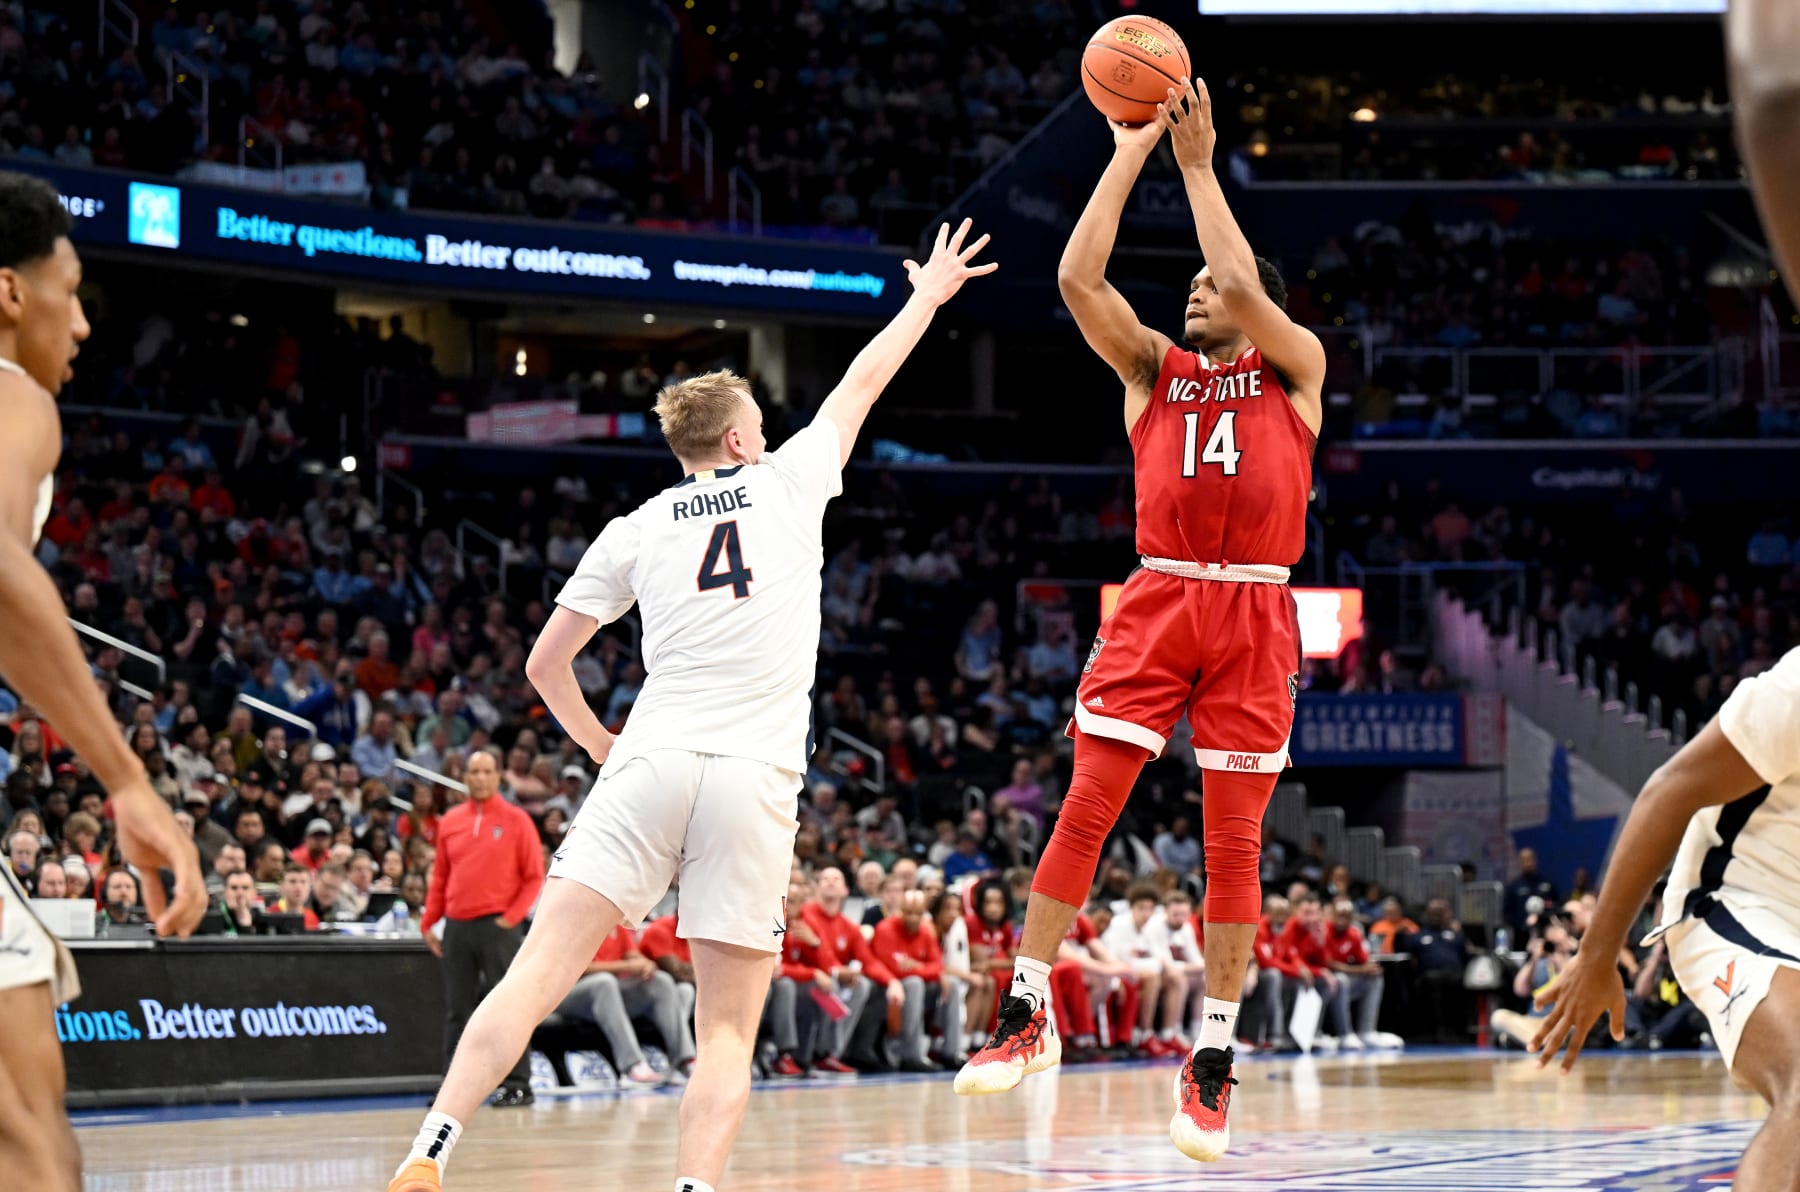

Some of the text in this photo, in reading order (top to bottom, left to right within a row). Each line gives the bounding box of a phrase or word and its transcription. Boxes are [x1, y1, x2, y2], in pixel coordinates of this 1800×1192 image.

[1115, 25, 1172, 55] LEGACY
[217, 206, 651, 281] Better questions. Better outcomes.
[1166, 376, 1202, 404] NC
[1181, 409, 1244, 478] 14
[672, 485, 753, 522] ROHDE
[697, 519, 753, 600] 4
[1302, 722, 1455, 752] GREATNESS
[1225, 754, 1262, 770] PACK
[139, 998, 237, 1040] Better
[240, 1000, 387, 1037] outcomes.
